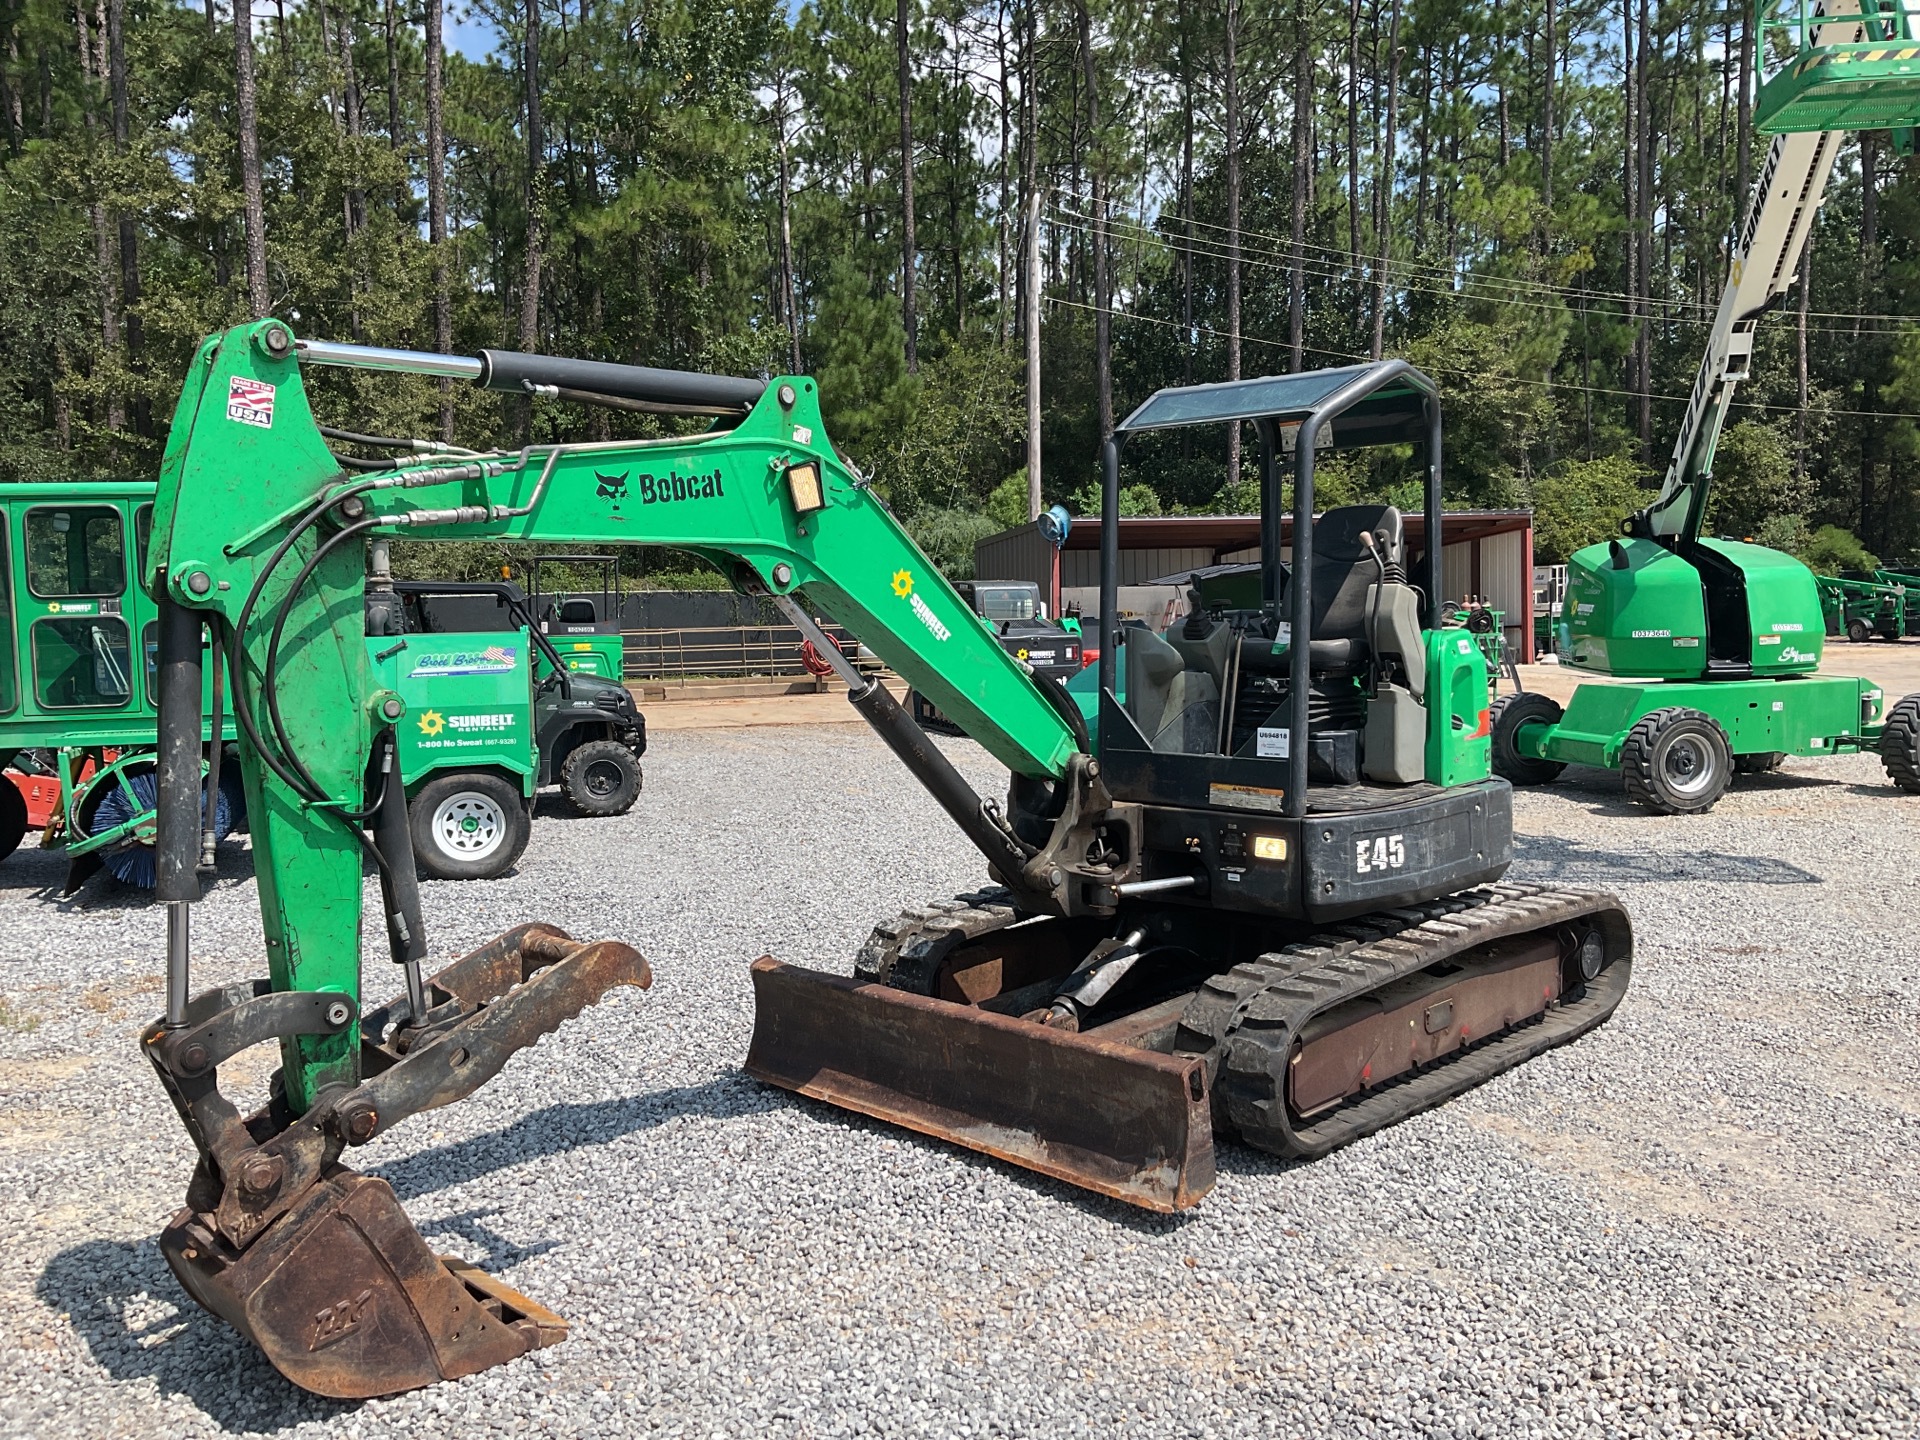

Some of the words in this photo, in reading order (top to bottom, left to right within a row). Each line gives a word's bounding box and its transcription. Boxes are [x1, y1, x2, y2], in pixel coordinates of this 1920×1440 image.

[1742, 136, 1781, 260] SUNBELT
[230, 406, 269, 424] USA
[639, 468, 724, 504] Bobcat
[910, 592, 952, 642] SUNBELT
[448, 714, 515, 728] SUNBELT
[456, 739, 483, 747] Sweat
[1355, 834, 1405, 873] E45
